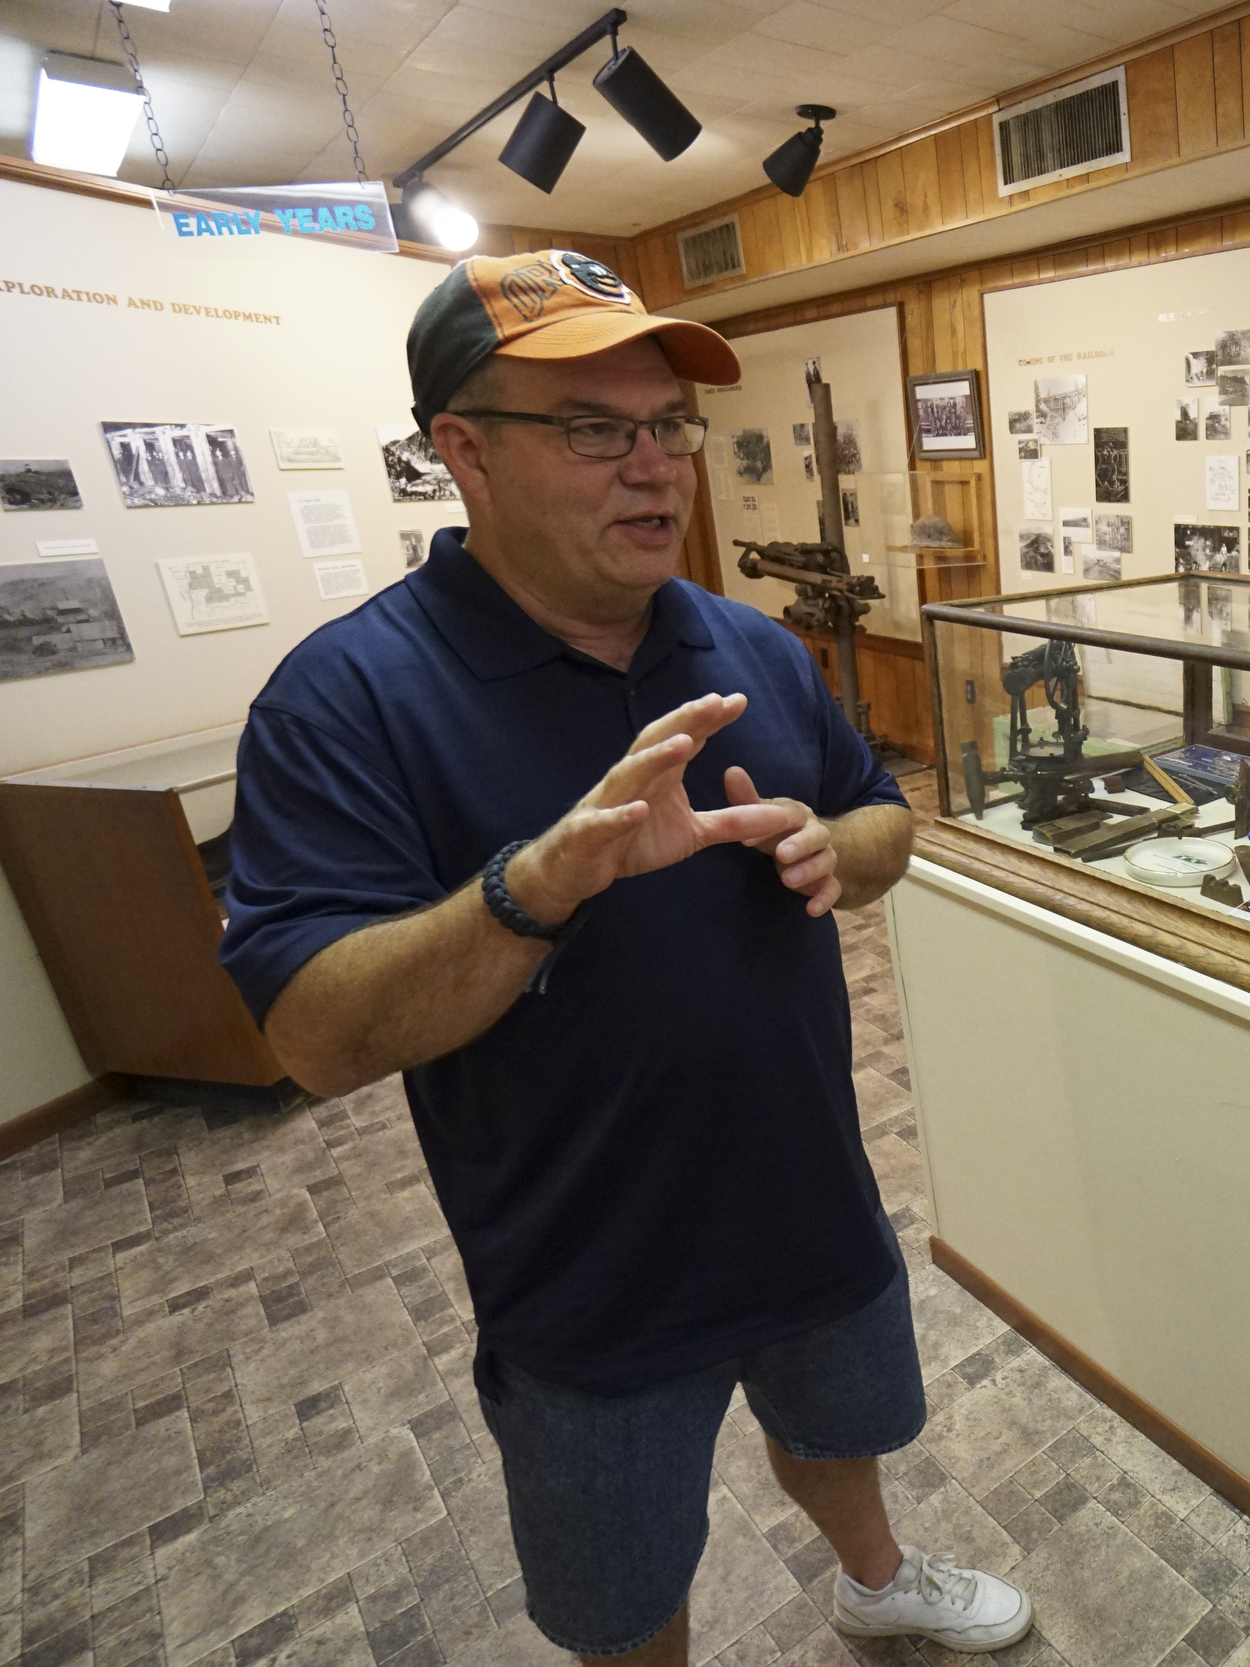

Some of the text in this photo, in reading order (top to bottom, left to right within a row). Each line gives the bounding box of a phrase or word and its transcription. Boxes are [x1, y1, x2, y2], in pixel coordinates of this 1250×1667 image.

[172, 203, 377, 238] EARLY YEARS
[0, 279, 282, 326] PLORATION AND DEVELOPMENT
[1060, 354, 1073, 362] THE
